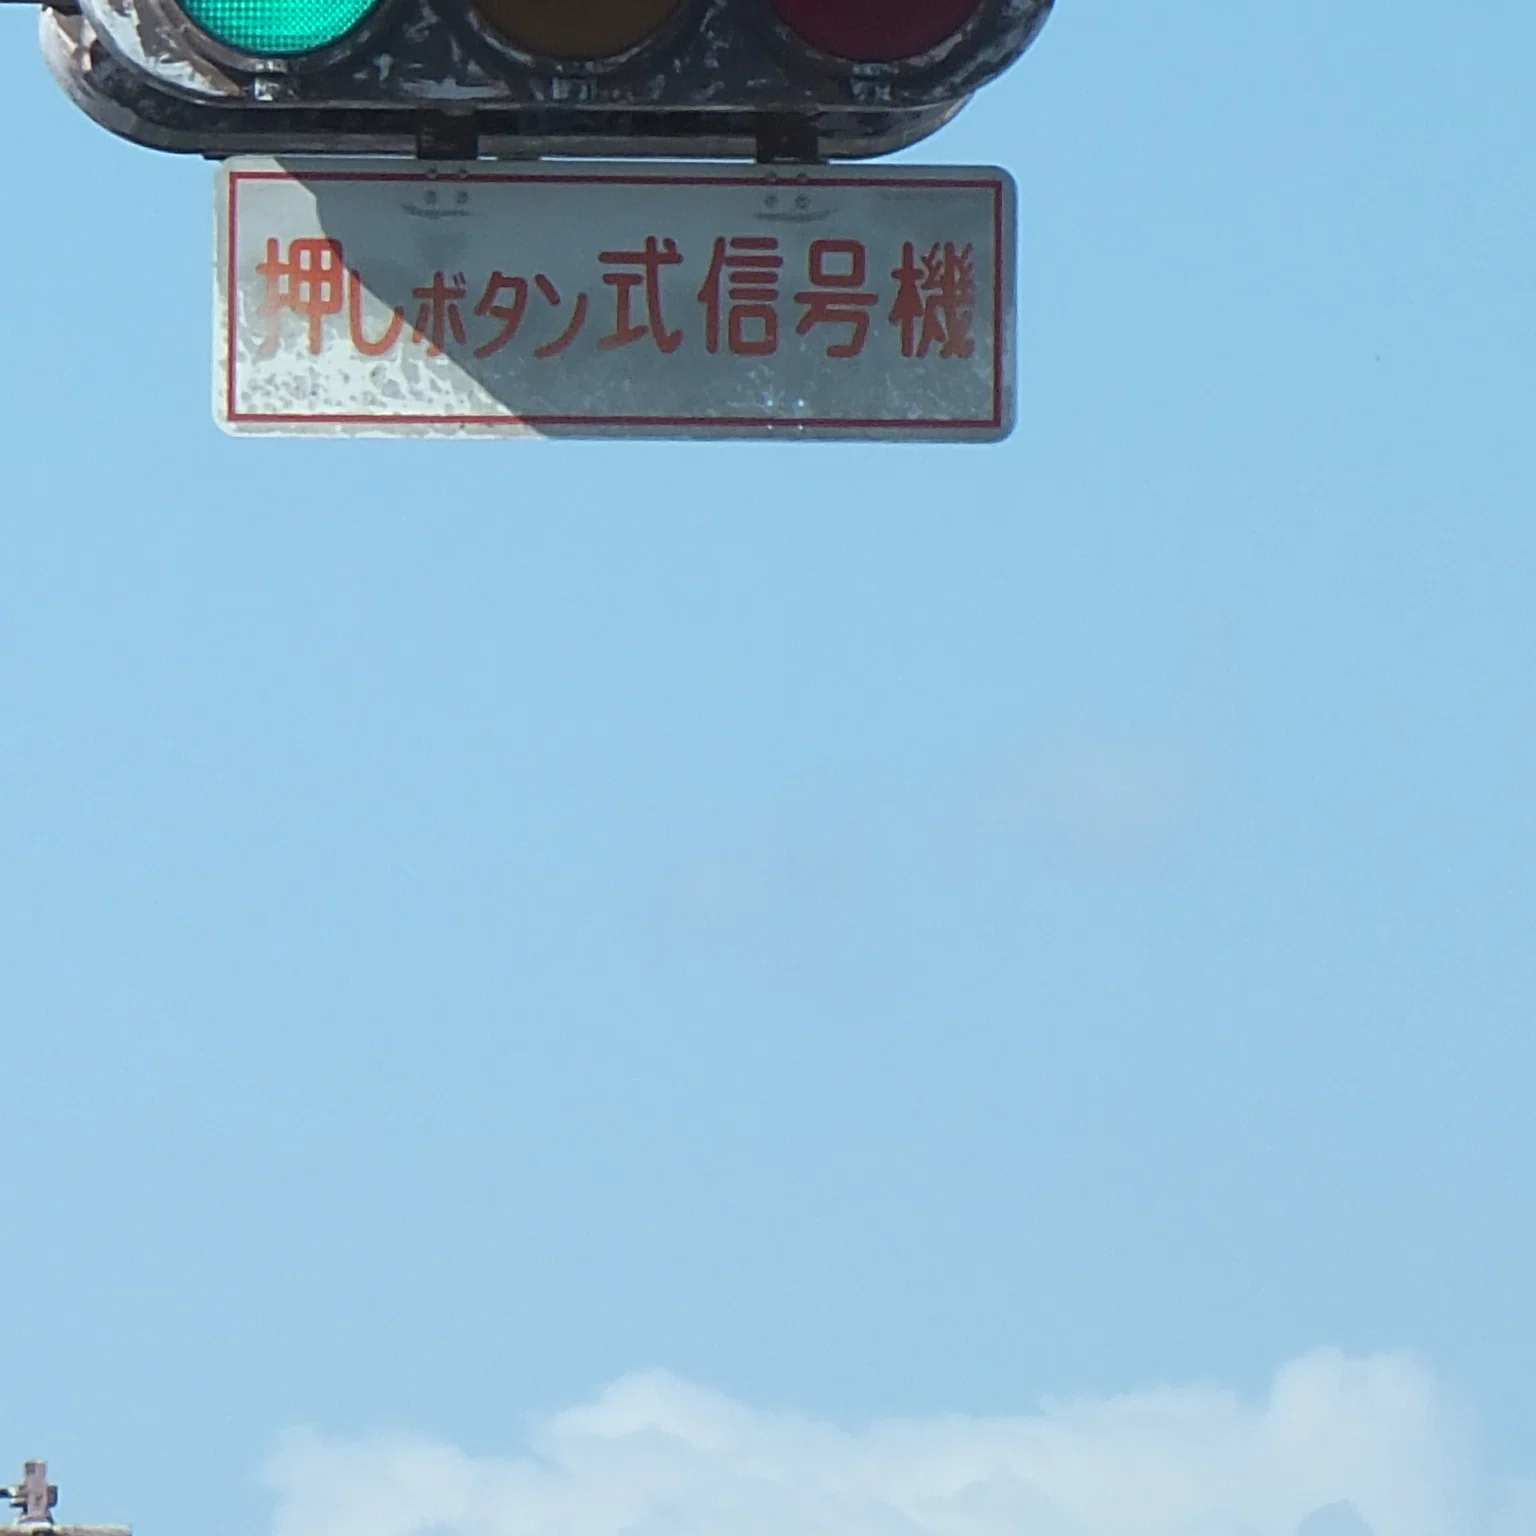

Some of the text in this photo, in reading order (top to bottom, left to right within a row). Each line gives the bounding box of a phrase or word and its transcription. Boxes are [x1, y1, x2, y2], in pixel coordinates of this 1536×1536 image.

[256, 235, 976, 359] 押しボタン式信号機
